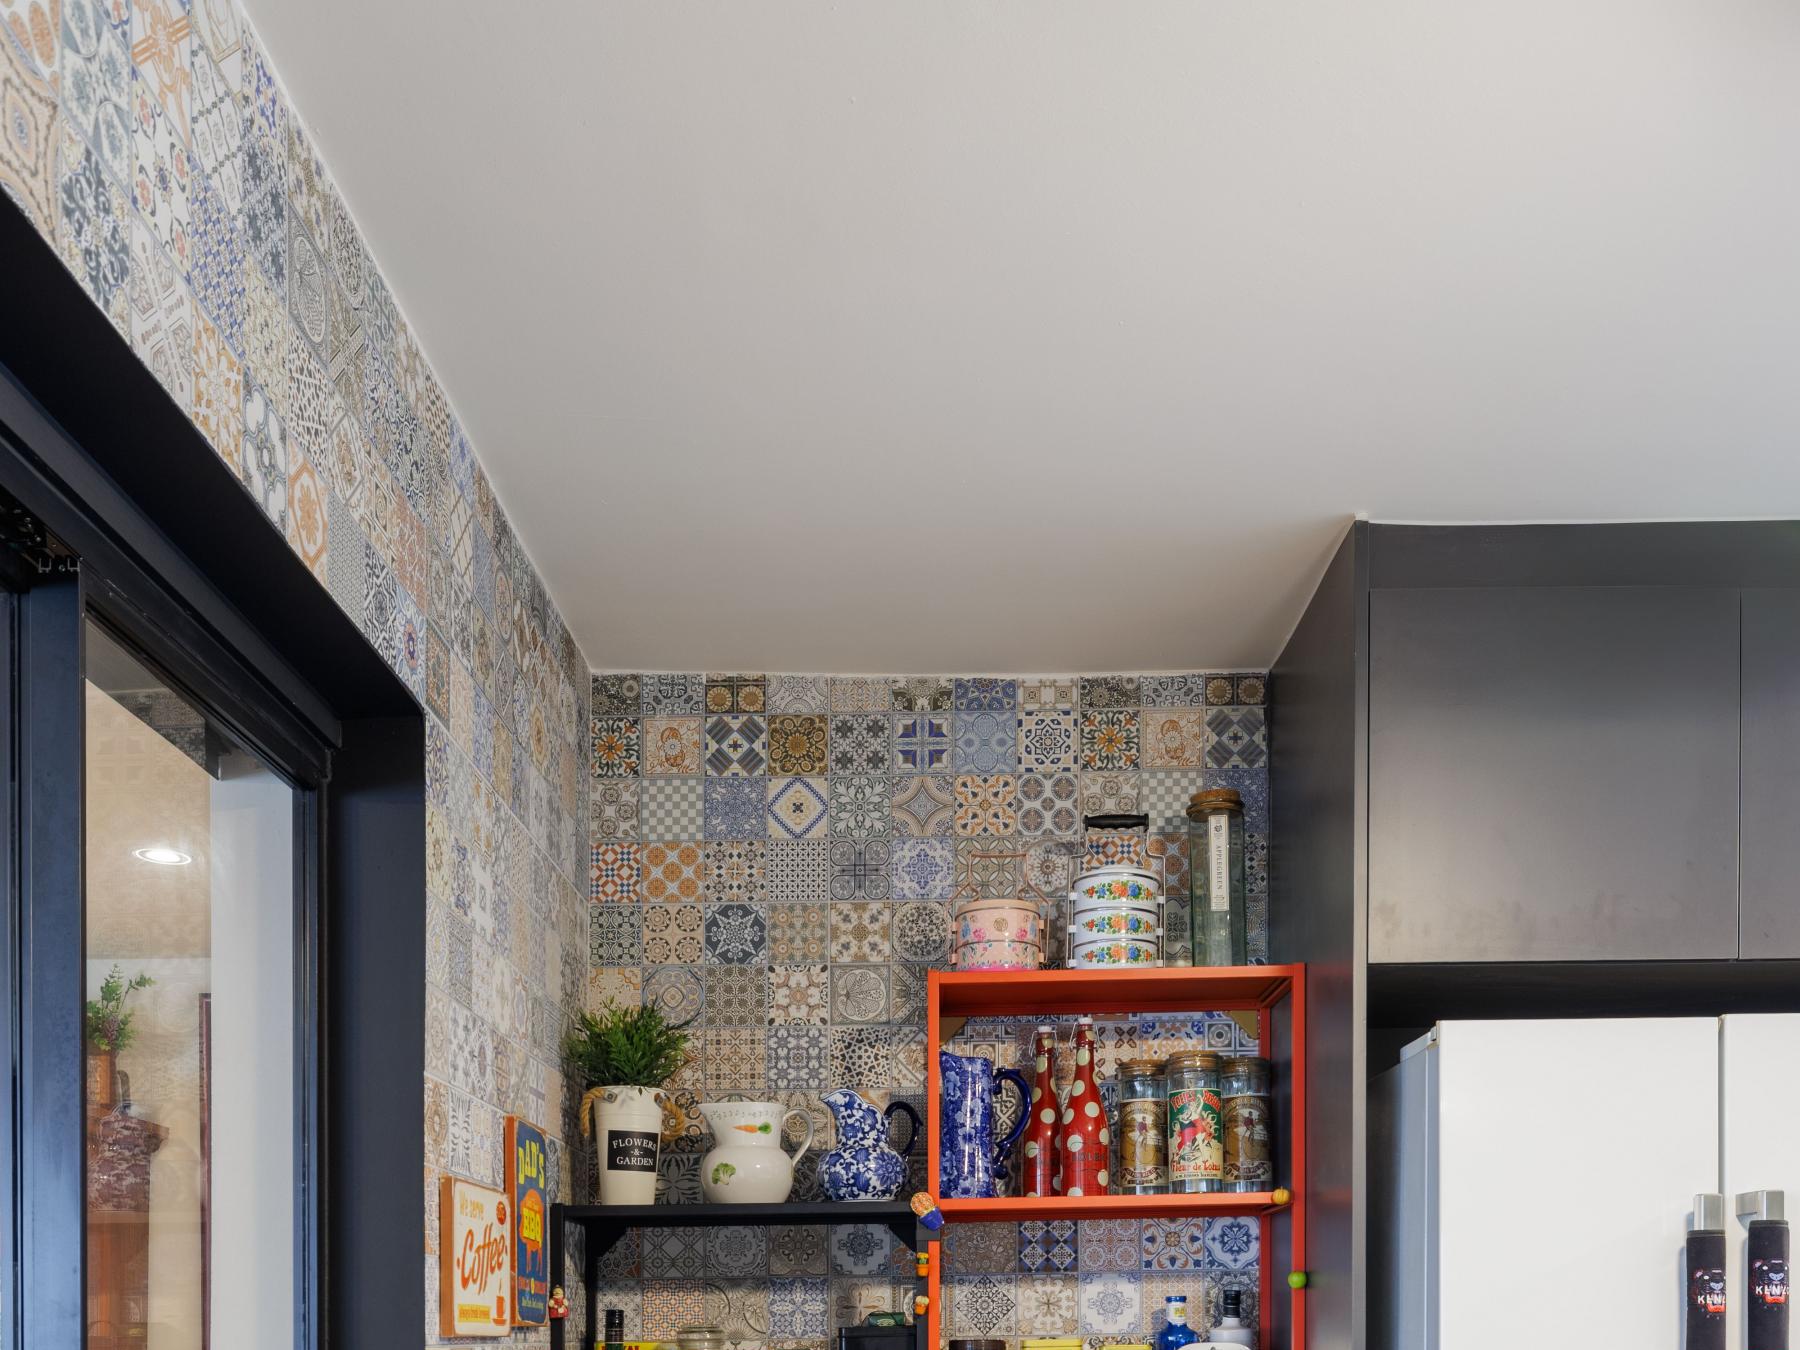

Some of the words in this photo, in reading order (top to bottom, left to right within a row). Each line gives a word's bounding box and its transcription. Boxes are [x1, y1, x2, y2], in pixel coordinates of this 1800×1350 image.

[518, 1139, 545, 1190] DAD'S
[612, 1138, 656, 1151] FLOWERS
[617, 1157, 654, 1166] GARDEN
[522, 1207, 542, 1248] BBQ
[461, 1222, 506, 1295] Coffee
